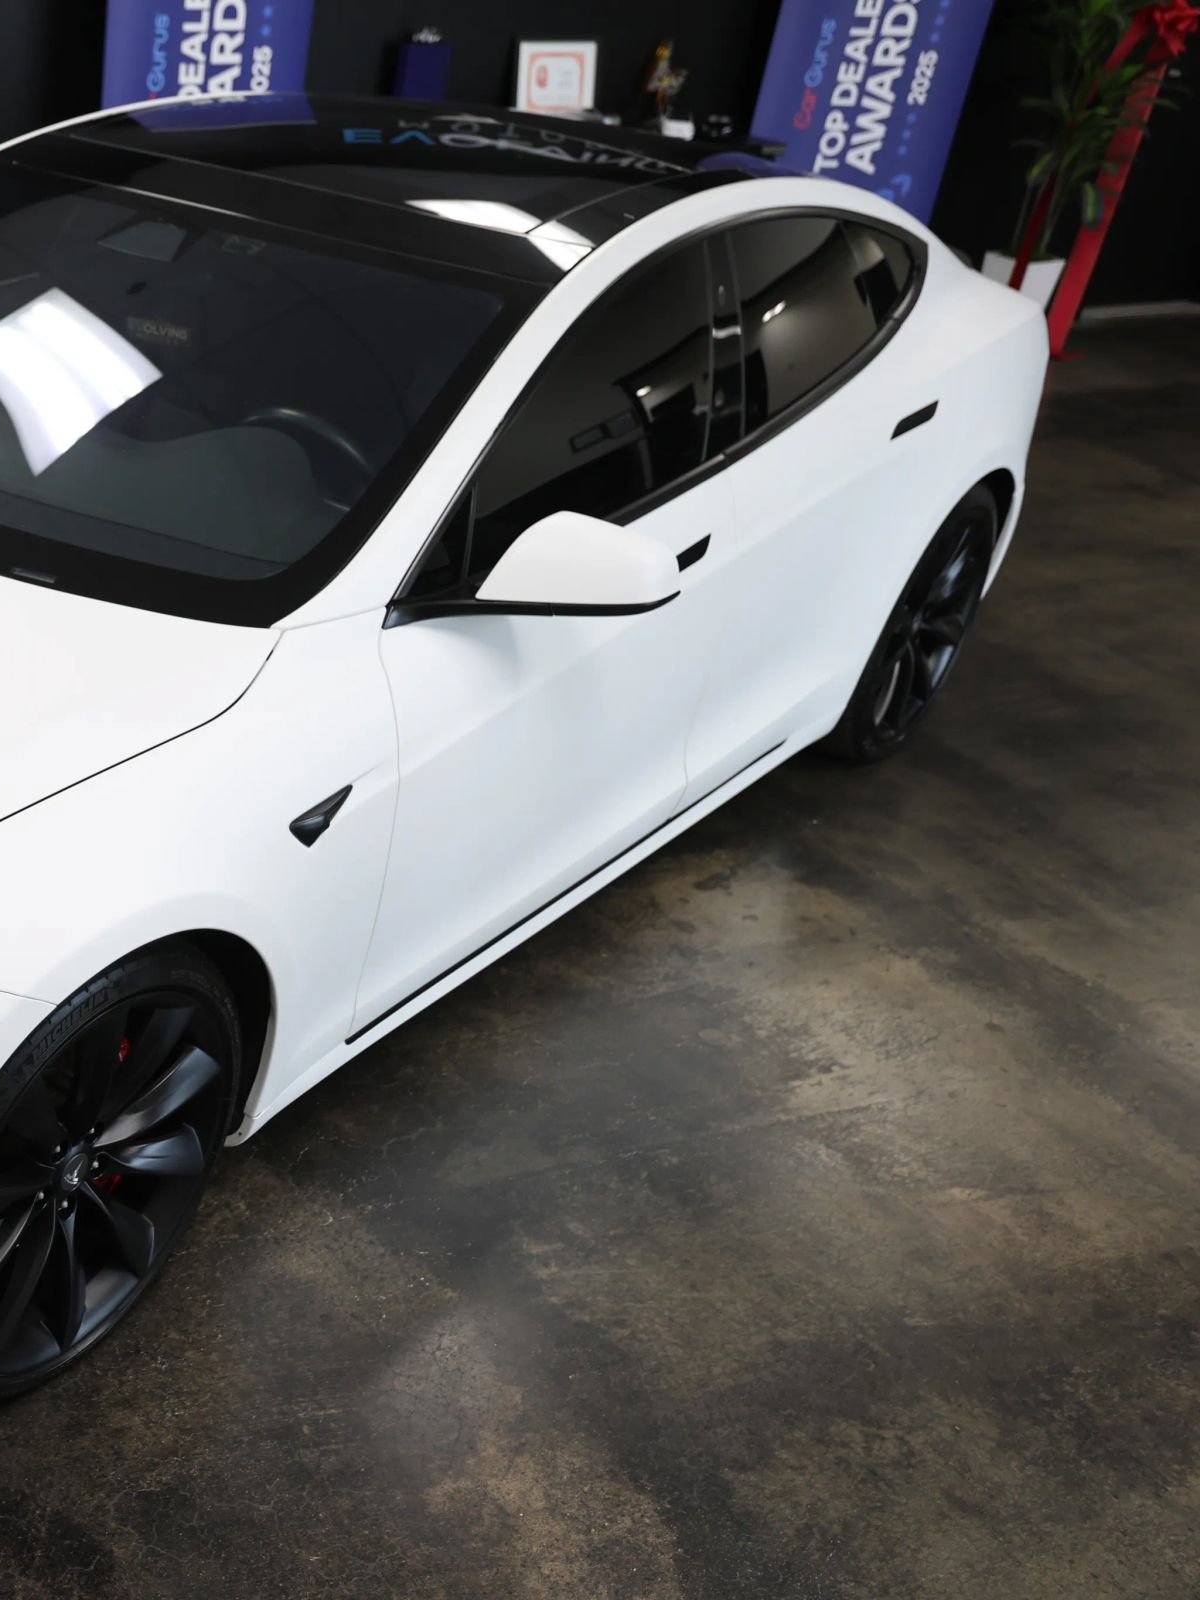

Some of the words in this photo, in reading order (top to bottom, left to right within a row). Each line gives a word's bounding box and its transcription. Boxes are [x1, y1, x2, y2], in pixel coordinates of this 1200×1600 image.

[207, 0, 247, 94] ARD
[250, 45, 273, 93] 025
[907, 49, 939, 106] 2025
[845, 0, 921, 175] AWARD
[811, 109, 850, 174] TOP
